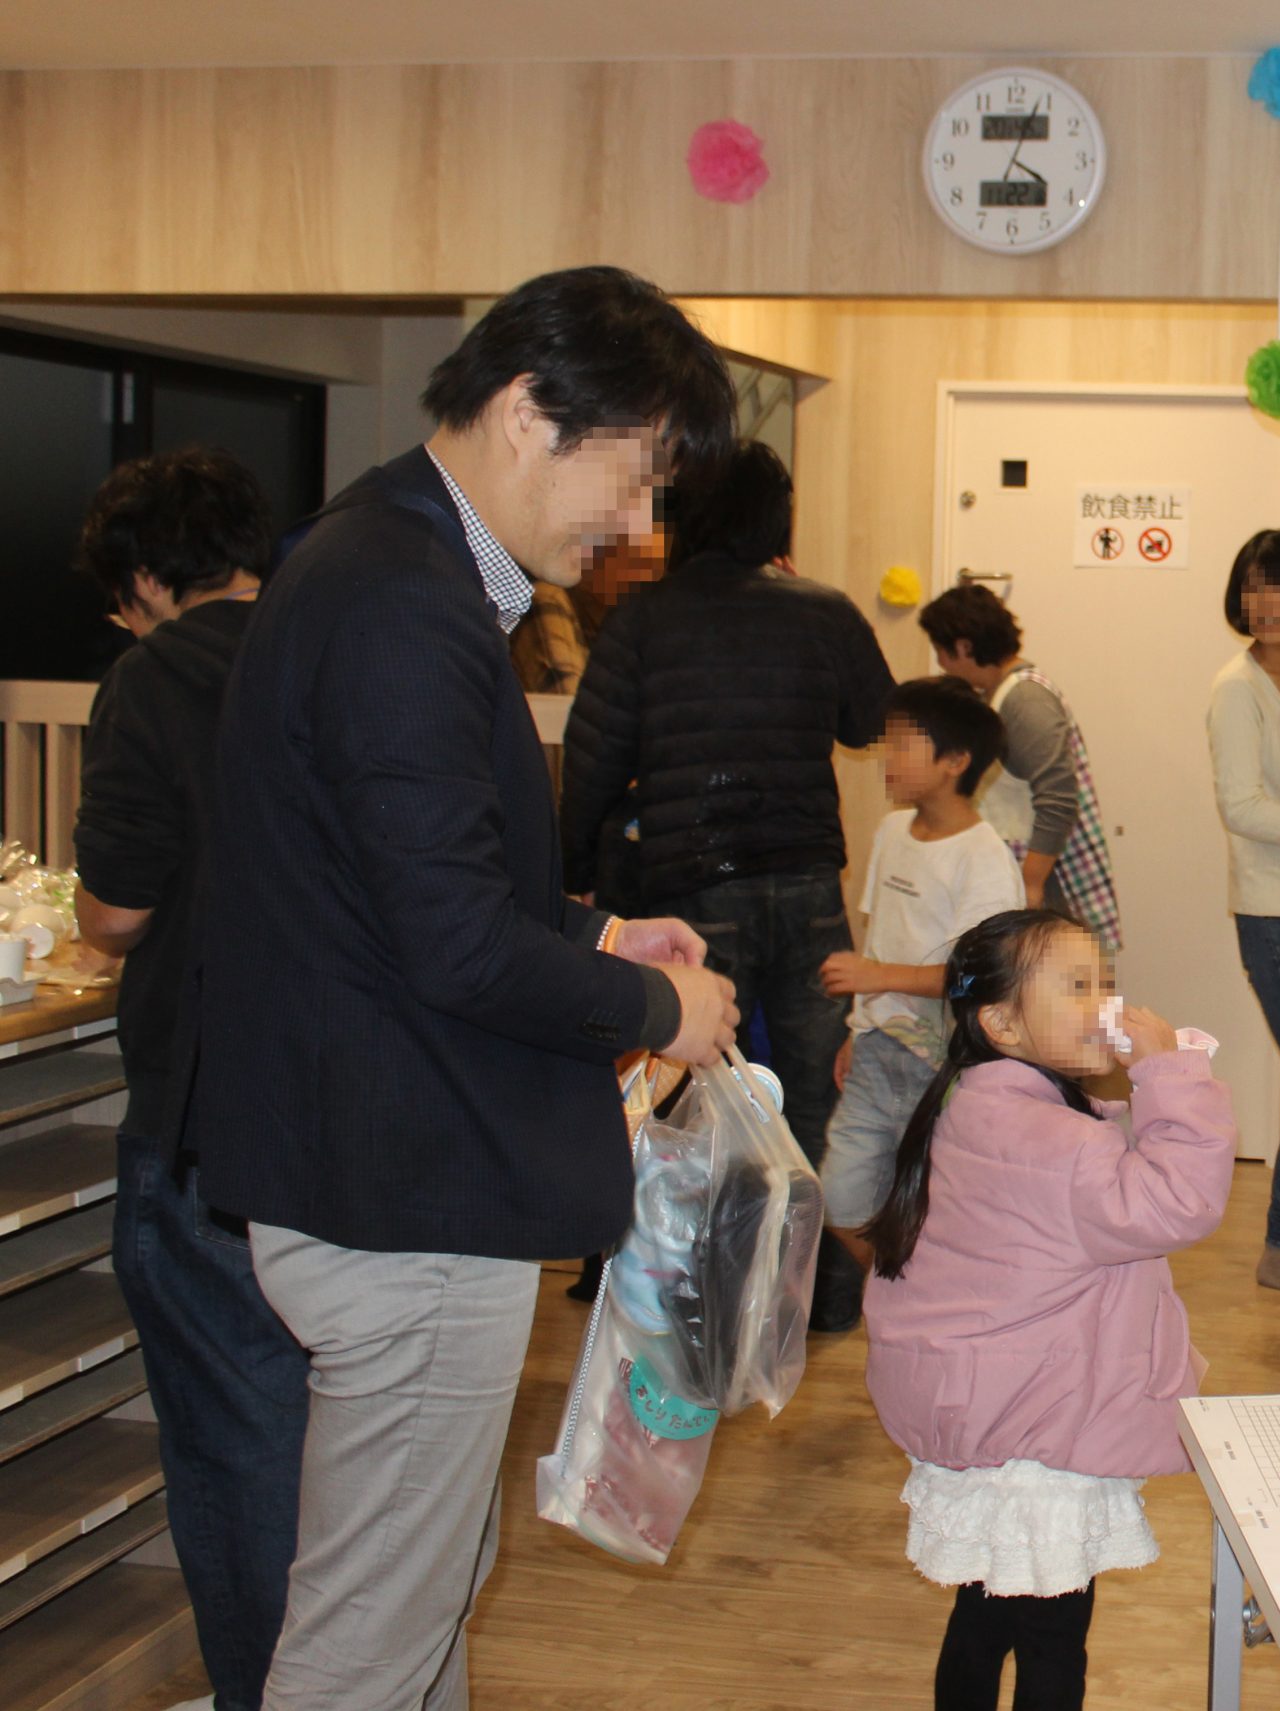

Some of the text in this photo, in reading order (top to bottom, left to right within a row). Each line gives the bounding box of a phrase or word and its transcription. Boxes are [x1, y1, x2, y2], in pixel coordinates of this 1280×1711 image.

[977, 94, 990, 111] 11
[1007, 86, 1025, 104] 12
[952, 119, 969, 137] 10
[1068, 118, 1080, 137] 2
[942, 153, 955, 170] 9
[1075, 151, 1087, 170] 3
[950, 186, 963, 206] 8
[976, 211, 987, 230] 7
[1006, 218, 1018, 236] 6
[1038, 211, 1050, 231] 5
[1081, 493, 1183, 520] 飲食禁止
